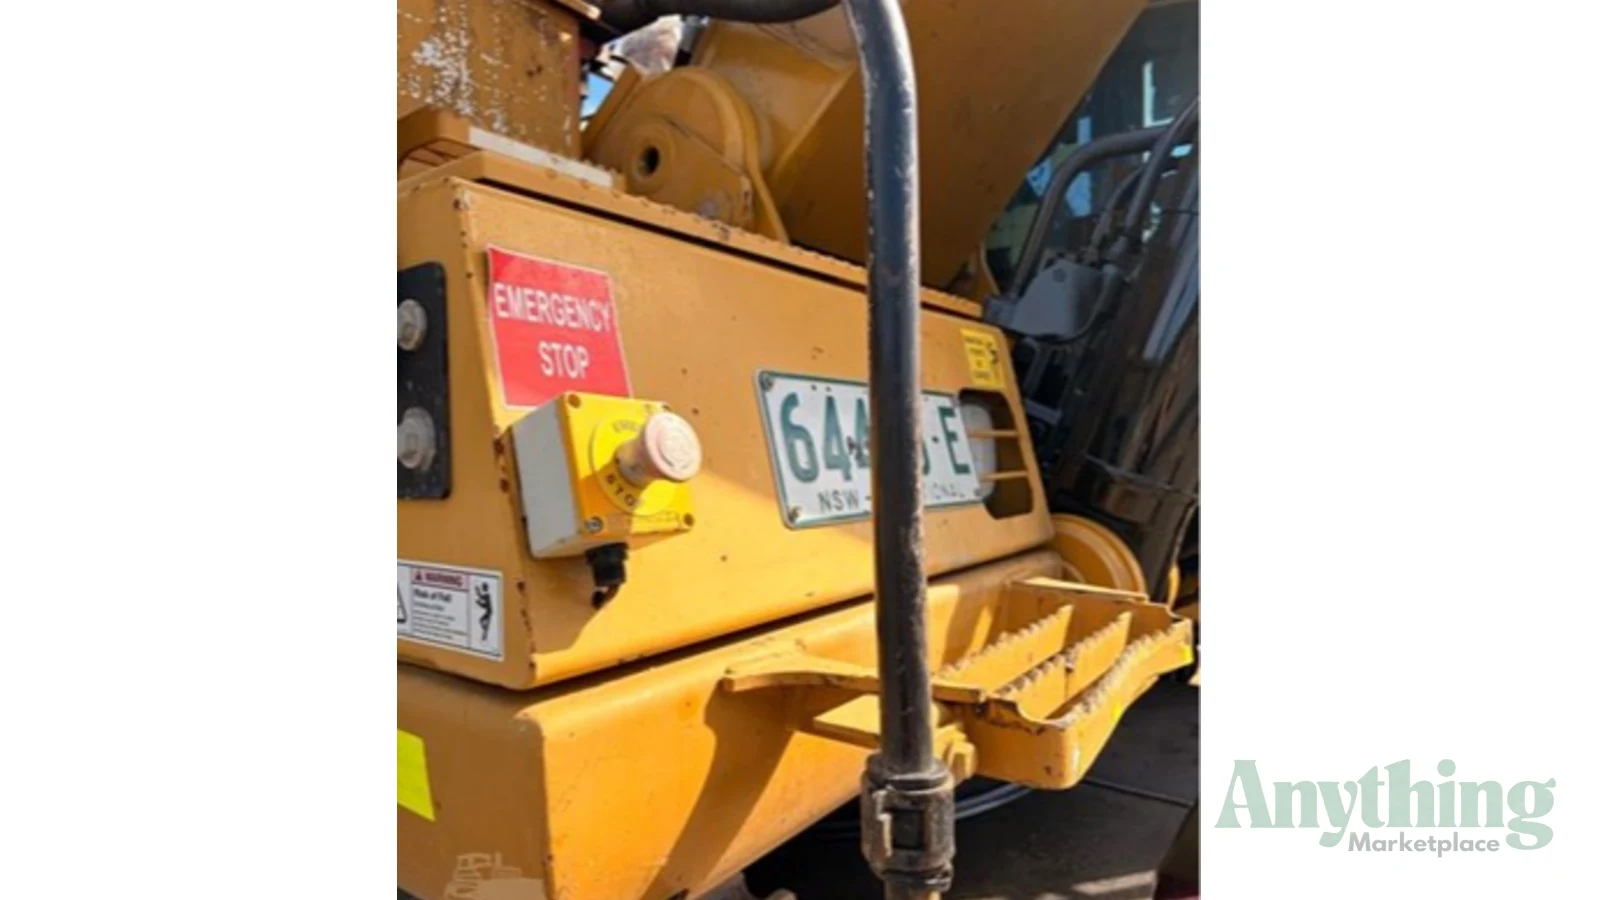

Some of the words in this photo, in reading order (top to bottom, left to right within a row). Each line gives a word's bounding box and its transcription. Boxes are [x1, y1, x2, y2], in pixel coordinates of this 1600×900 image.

[493, 282, 612, 332] EMERGENCY
[538, 339, 590, 378] STOP
[816, 488, 860, 513] NSW
